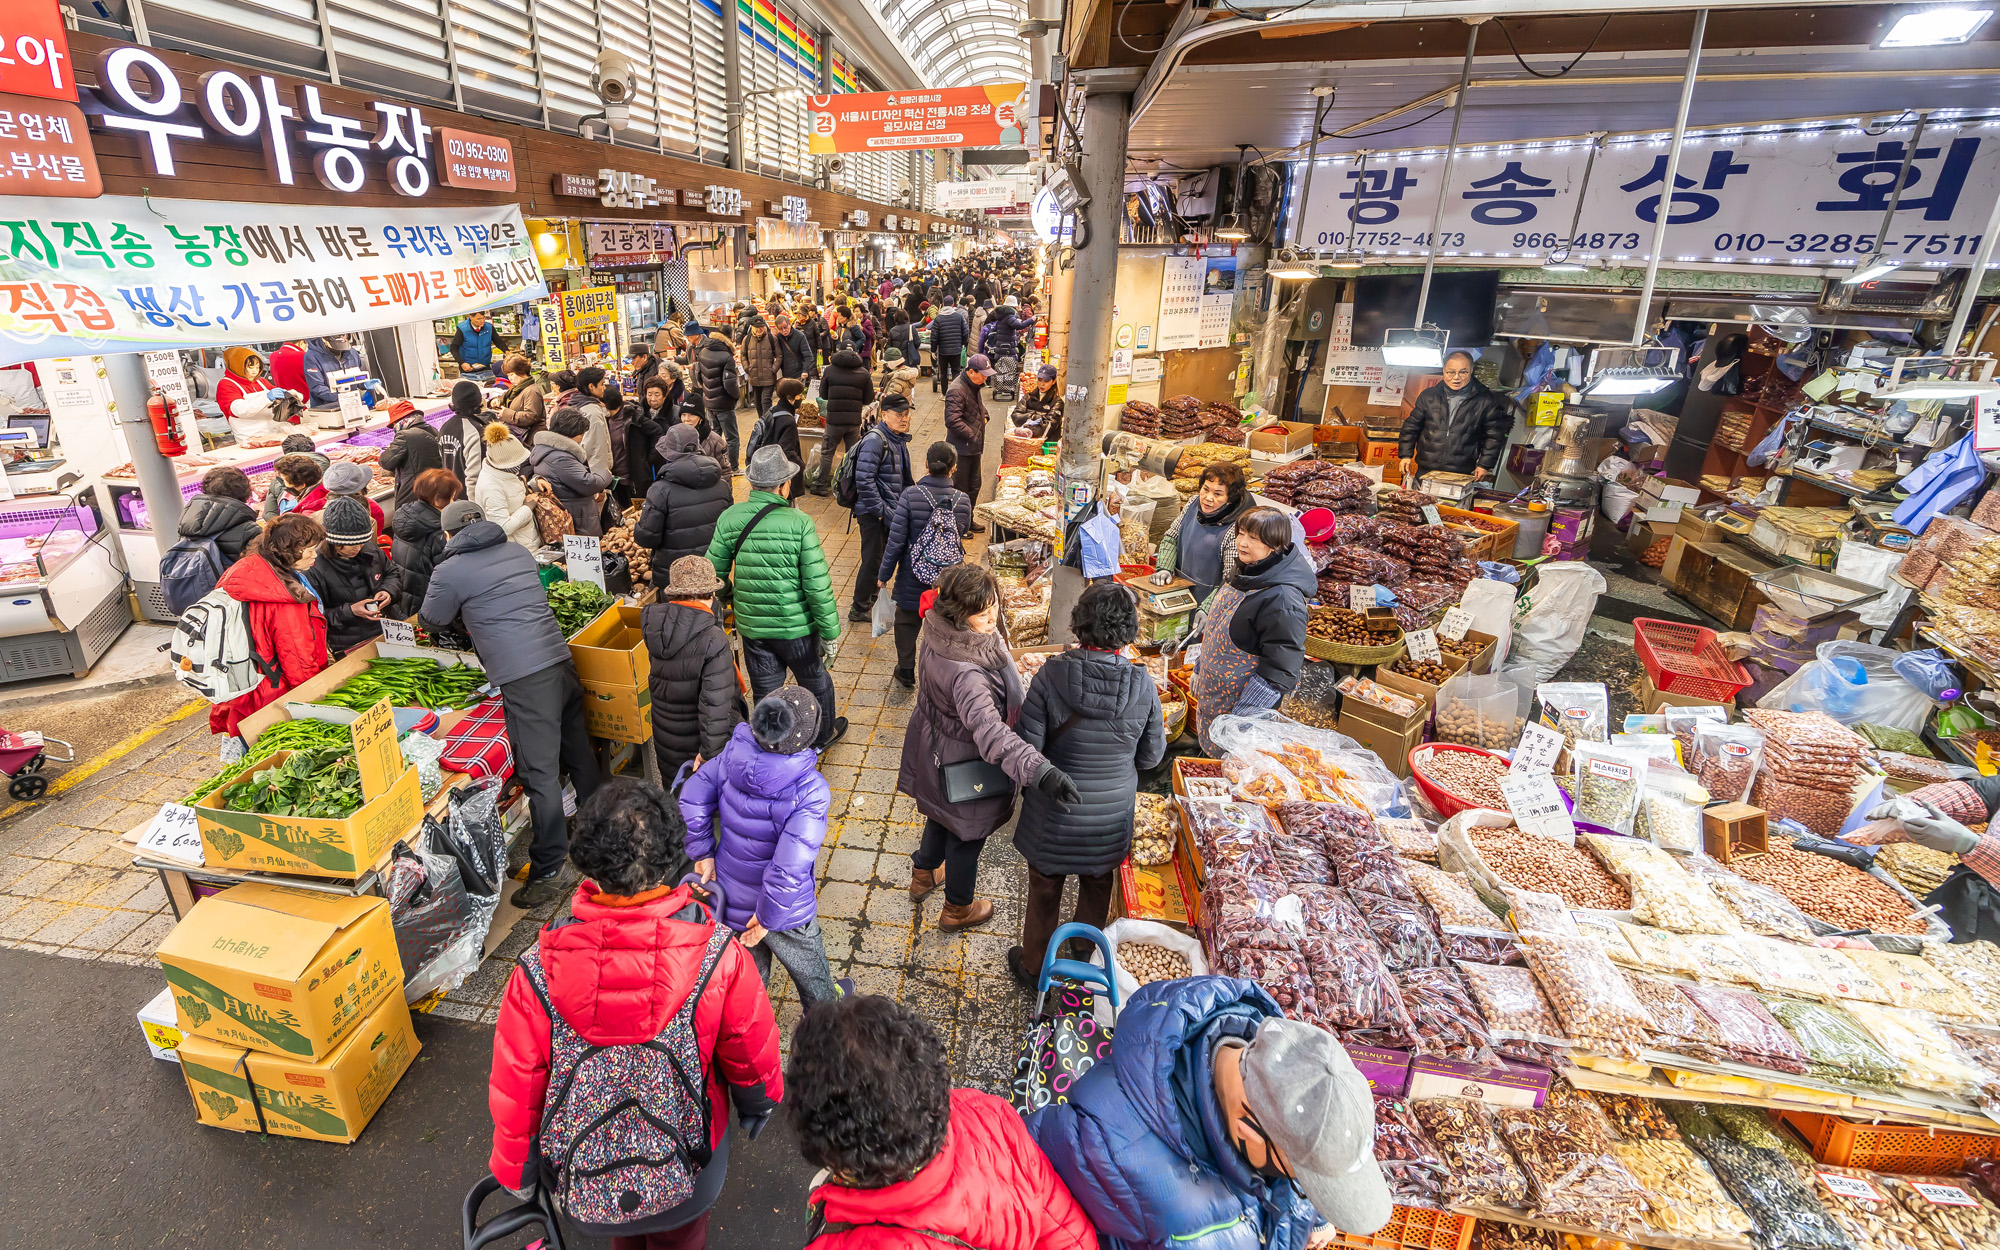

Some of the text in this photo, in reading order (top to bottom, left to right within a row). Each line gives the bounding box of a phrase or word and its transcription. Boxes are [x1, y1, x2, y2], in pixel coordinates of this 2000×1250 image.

[103, 46, 432, 197] 우아농장
[840, 104, 991, 122] 서울시 디자인 혁신 전통시장 조성
[998, 105, 1016, 122] 축
[816, 116, 833, 133] 경
[883, 119, 946, 132] 공모사업 선정
[449, 139, 508, 163] 02) 962-0300
[453, 163, 482, 179] 세살 입맛
[705, 184, 741, 216] 진광젓갈
[164, 224, 316, 265] 농장에서
[316, 225, 380, 261] 바로
[383, 225, 453, 259] 우리집
[456, 222, 521, 254] 식탁으로
[600, 228, 665, 251] 진광젓갈
[1318, 231, 1466, 247] 010-7752-4873
[1512, 232, 1640, 249] 966-4873
[1714, 232, 1983, 255] 010-3285-7511
[1185, 260, 1189, 269] 2
[591, 275, 616, 284] 창신푸드
[0, 257, 541, 333] 직접 생산,가공하여 도매가로 판매합니다
[564, 290, 615, 318] 홍어회무침
[542, 307, 563, 363] 홍어무침
[1594, 762, 1628, 776] 피스타치오
[1168, 884, 1187, 915] 상주곶감
[211, 936, 270, 959] 감사합니다
[332, 969, 388, 1026] 공동규격출하
[1350, 1050, 1393, 1061] WALNUTS
[1827, 1177, 1869, 1192] 브라질넛
[1921, 1186, 1965, 1199] 브라질넛
